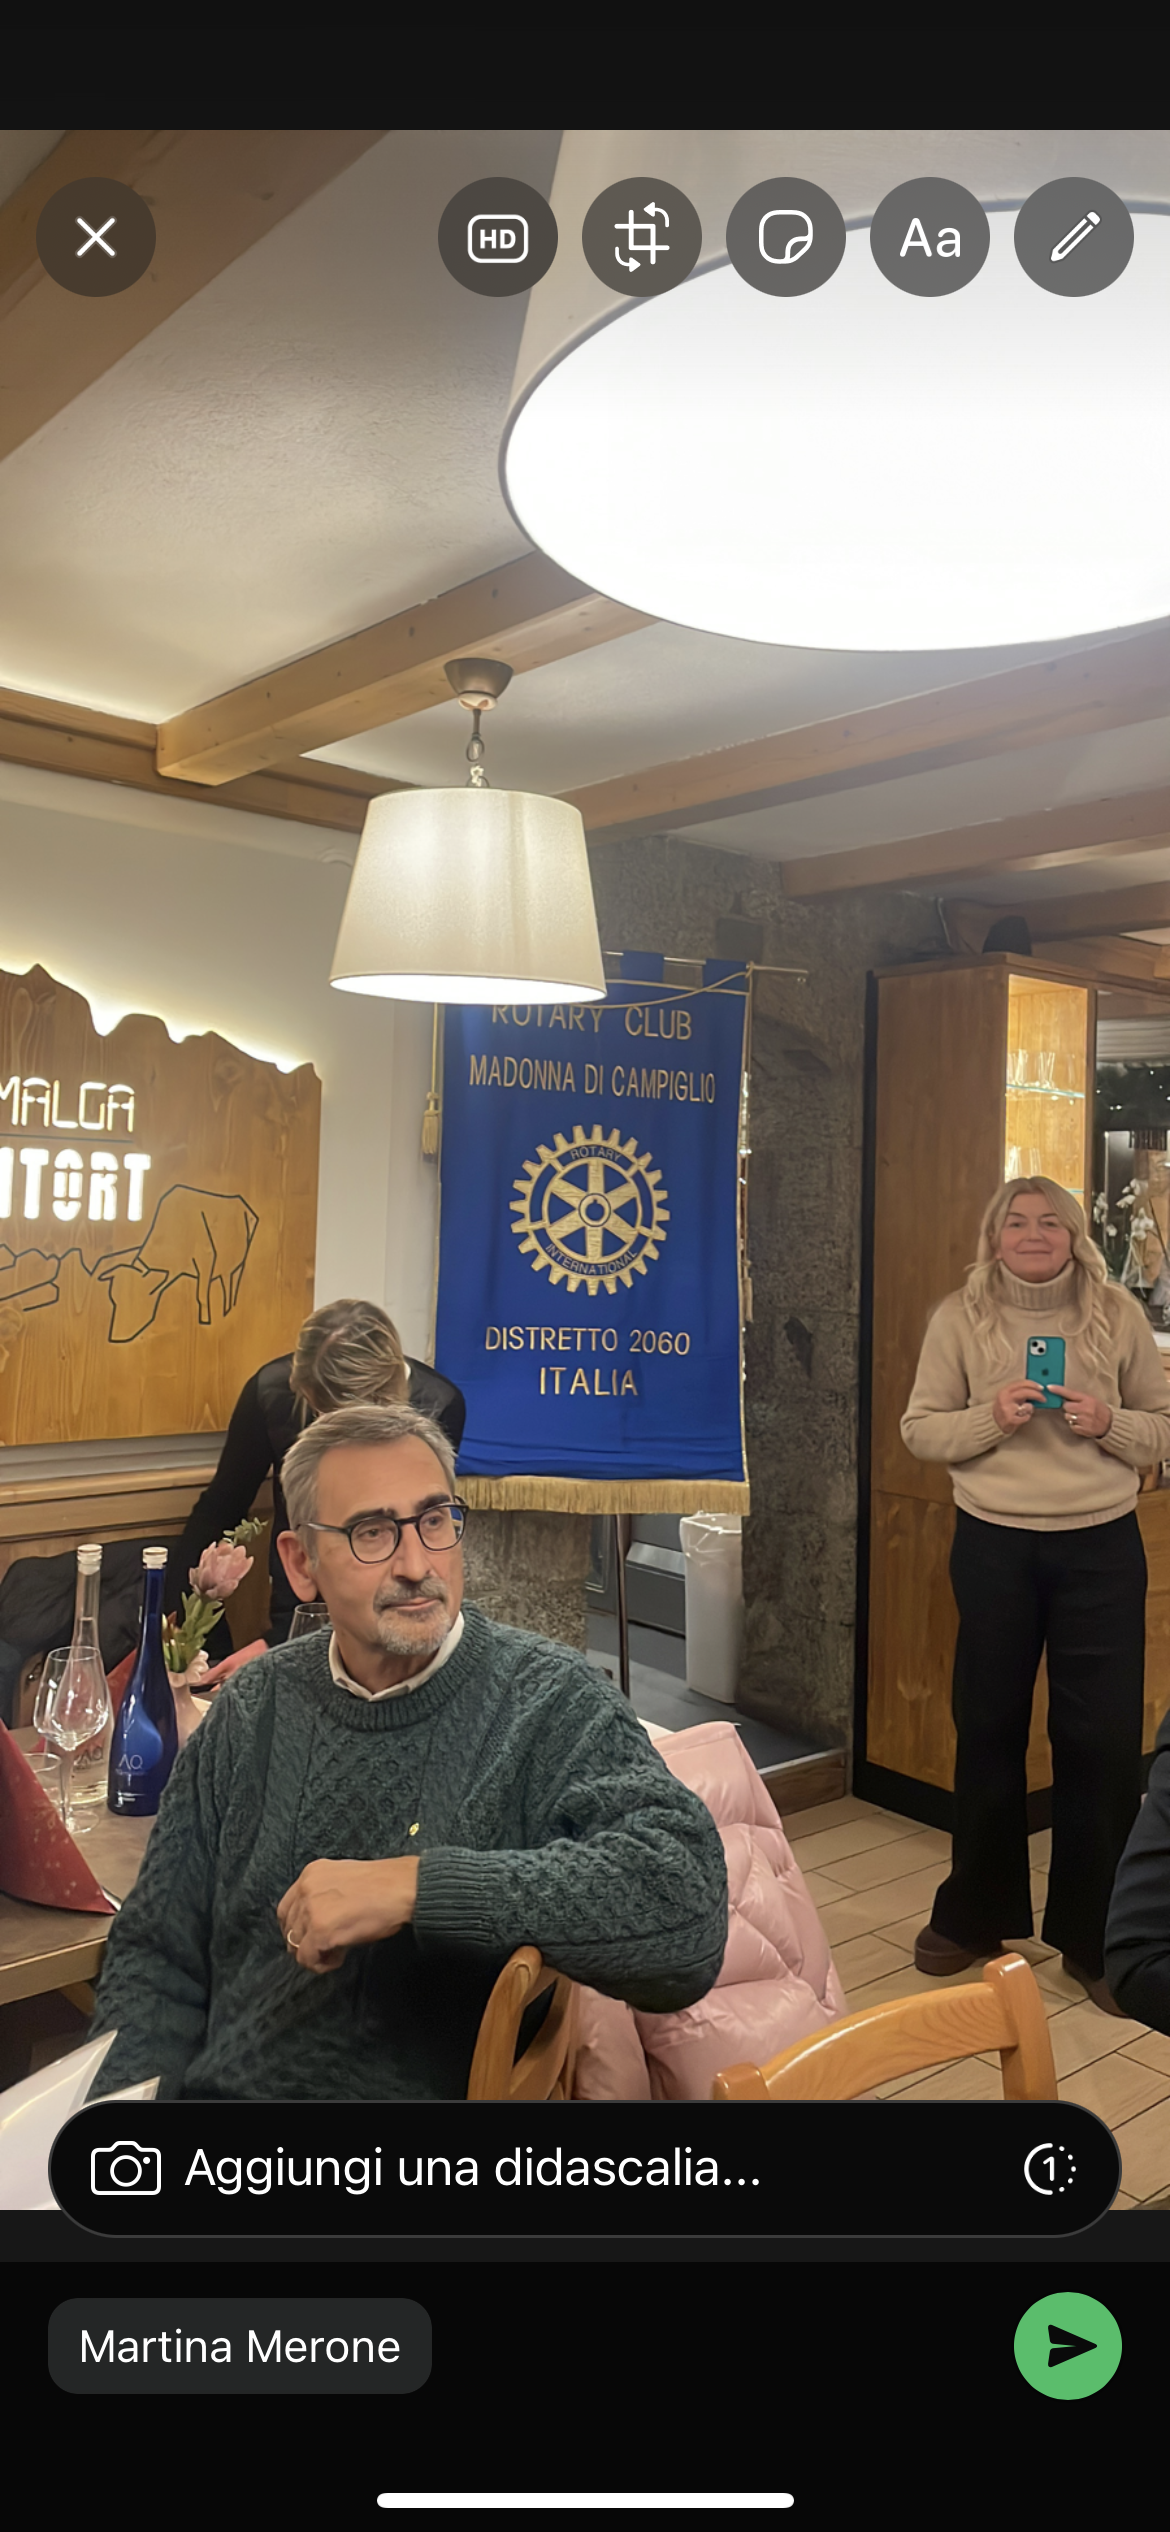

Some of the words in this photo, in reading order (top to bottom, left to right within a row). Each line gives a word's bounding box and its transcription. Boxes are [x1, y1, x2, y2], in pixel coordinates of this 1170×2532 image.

[624, 1006, 692, 1041] CLUB
[468, 1054, 577, 1093] MADONNA
[584, 1063, 604, 1096] DI
[611, 1065, 716, 1104] CAMPIGLIO
[0, 1075, 136, 1133] MALGA
[569, 1145, 622, 1162] ROTARY
[544, 1243, 639, 1275] INTERNATIONAL
[485, 1326, 619, 1353] DISTRETTO
[629, 1330, 691, 1356] 2060
[539, 1367, 639, 1397] ITALIA
